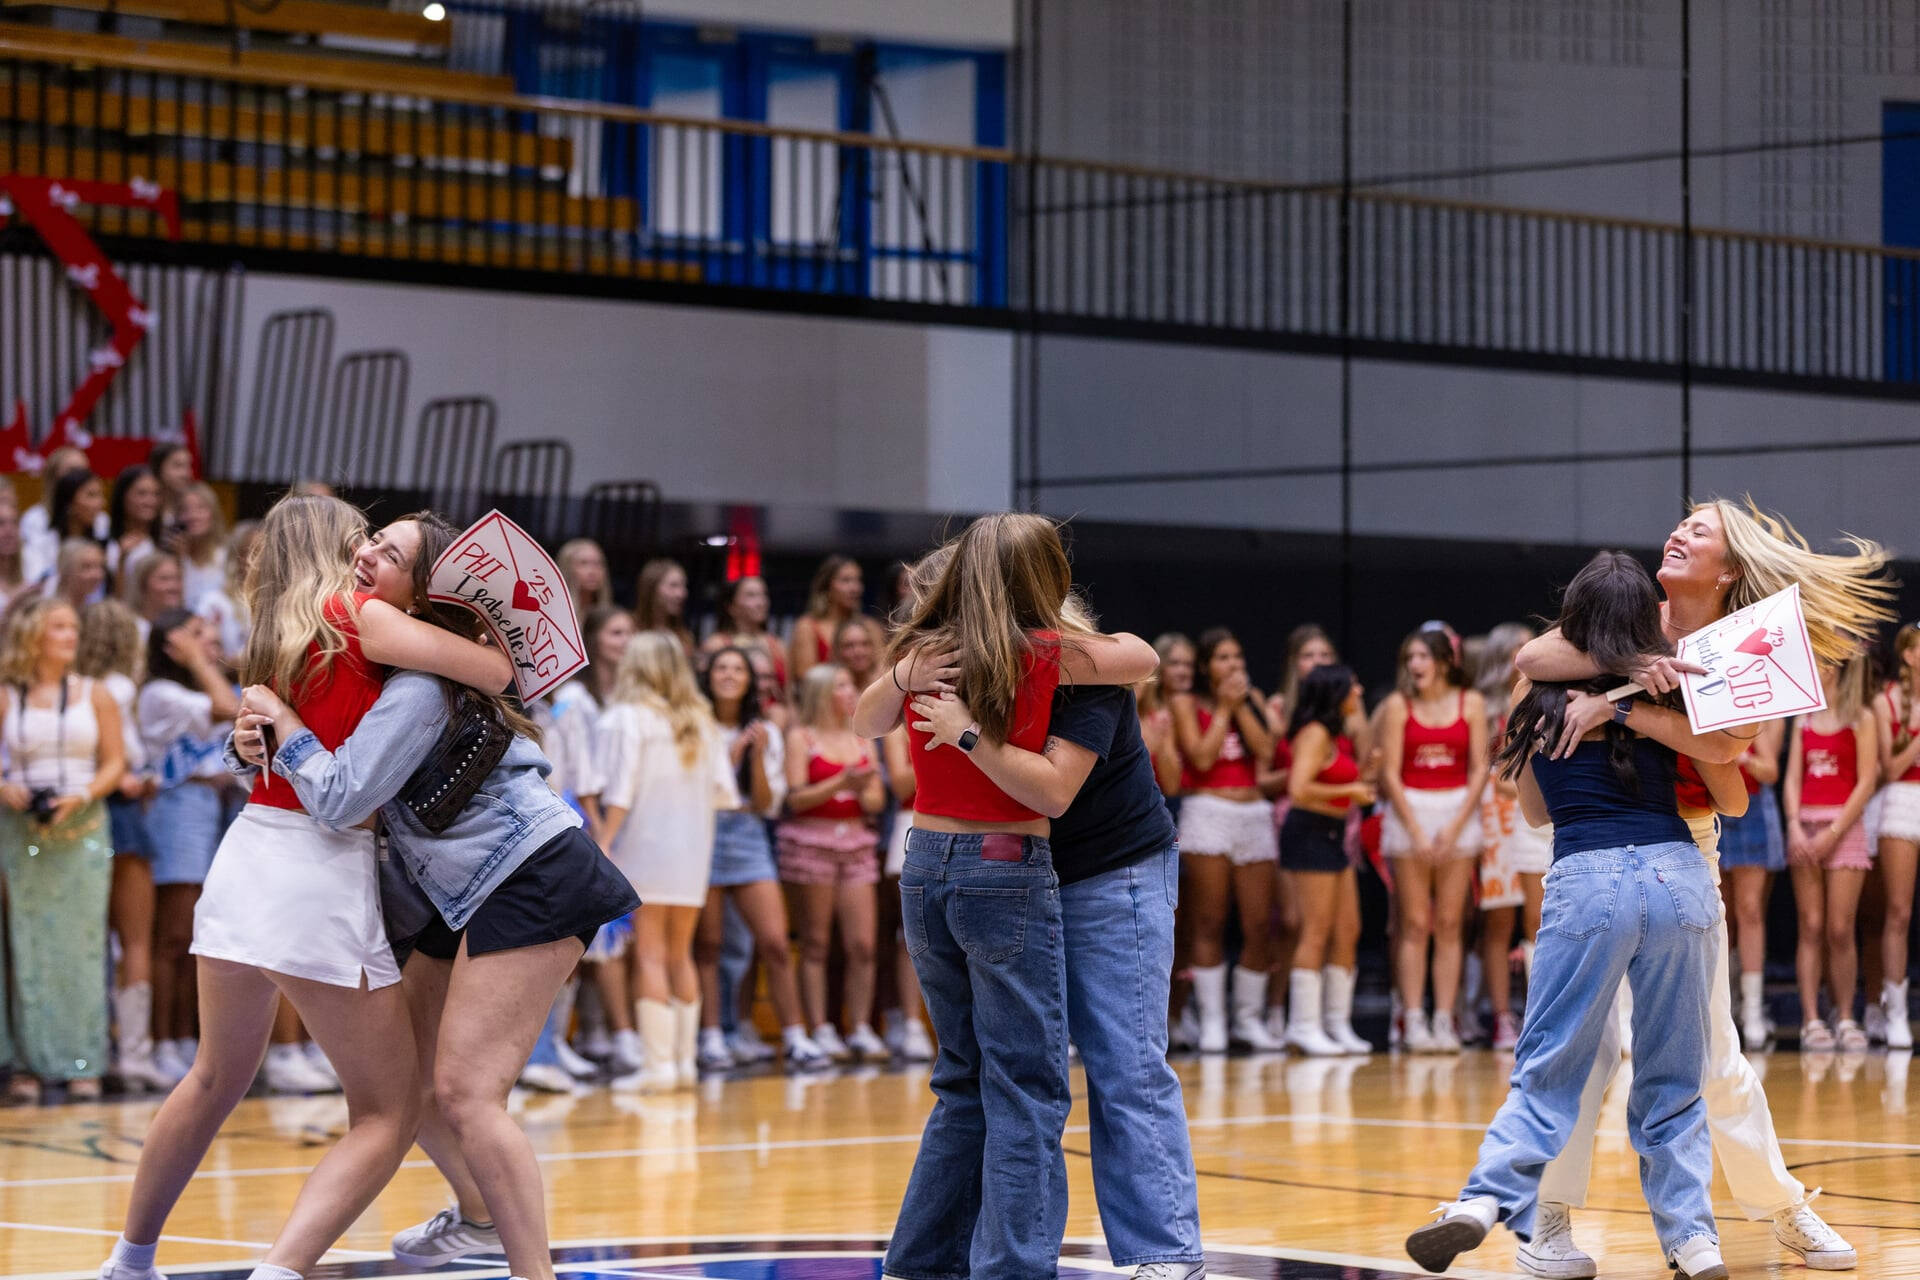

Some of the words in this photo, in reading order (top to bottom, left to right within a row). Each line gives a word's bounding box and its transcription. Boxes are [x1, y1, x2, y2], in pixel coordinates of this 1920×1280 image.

[446, 572, 525, 653] Isabelle
[452, 542, 509, 583] PHI
[525, 617, 559, 679] SIG
[1726, 658, 1774, 710] SIG
